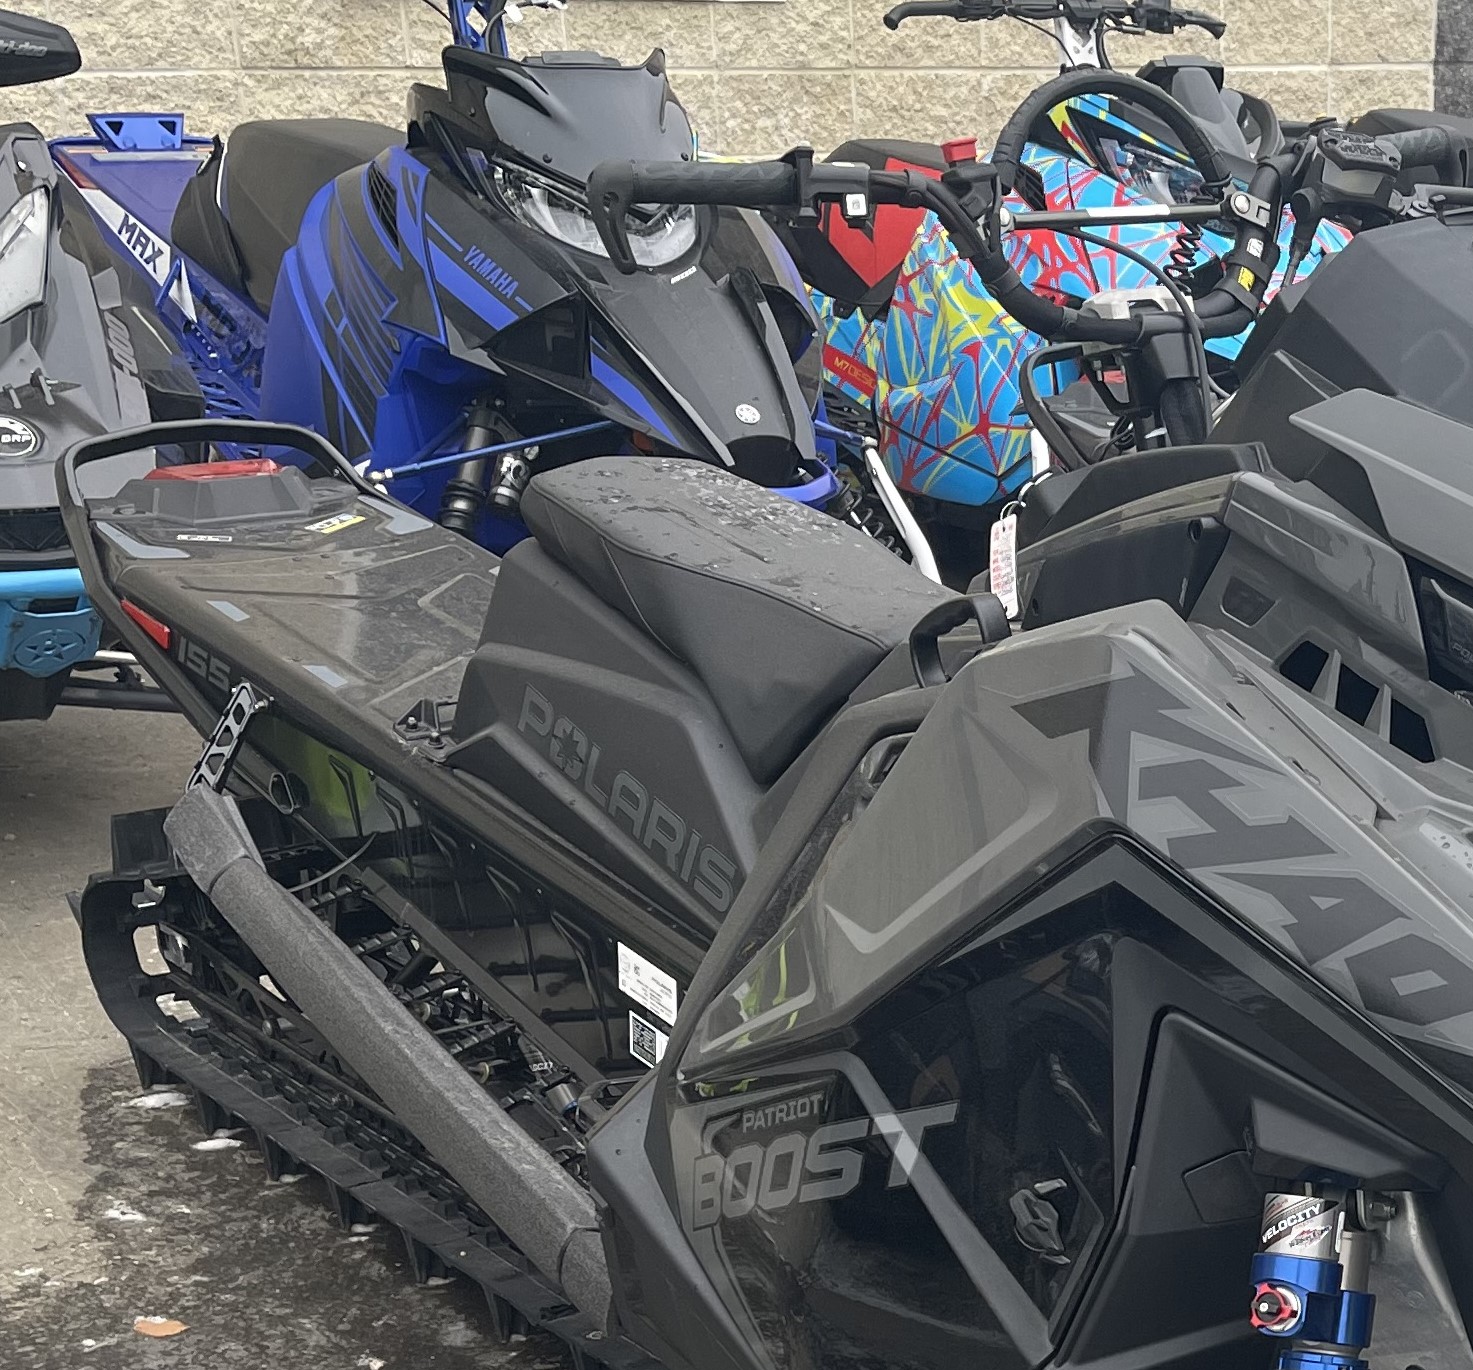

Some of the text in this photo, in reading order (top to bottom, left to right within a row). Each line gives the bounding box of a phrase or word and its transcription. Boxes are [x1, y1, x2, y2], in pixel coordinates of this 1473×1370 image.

[118, 213, 164, 274] MAX
[462, 245, 519, 298] YAMAHA
[177, 635, 233, 695] 155
[517, 681, 740, 913] POLARIS
[742, 1093, 824, 1133] PATRIOT
[692, 1100, 960, 1232] BOOST
[1261, 1203, 1321, 1244] VELOCITY
